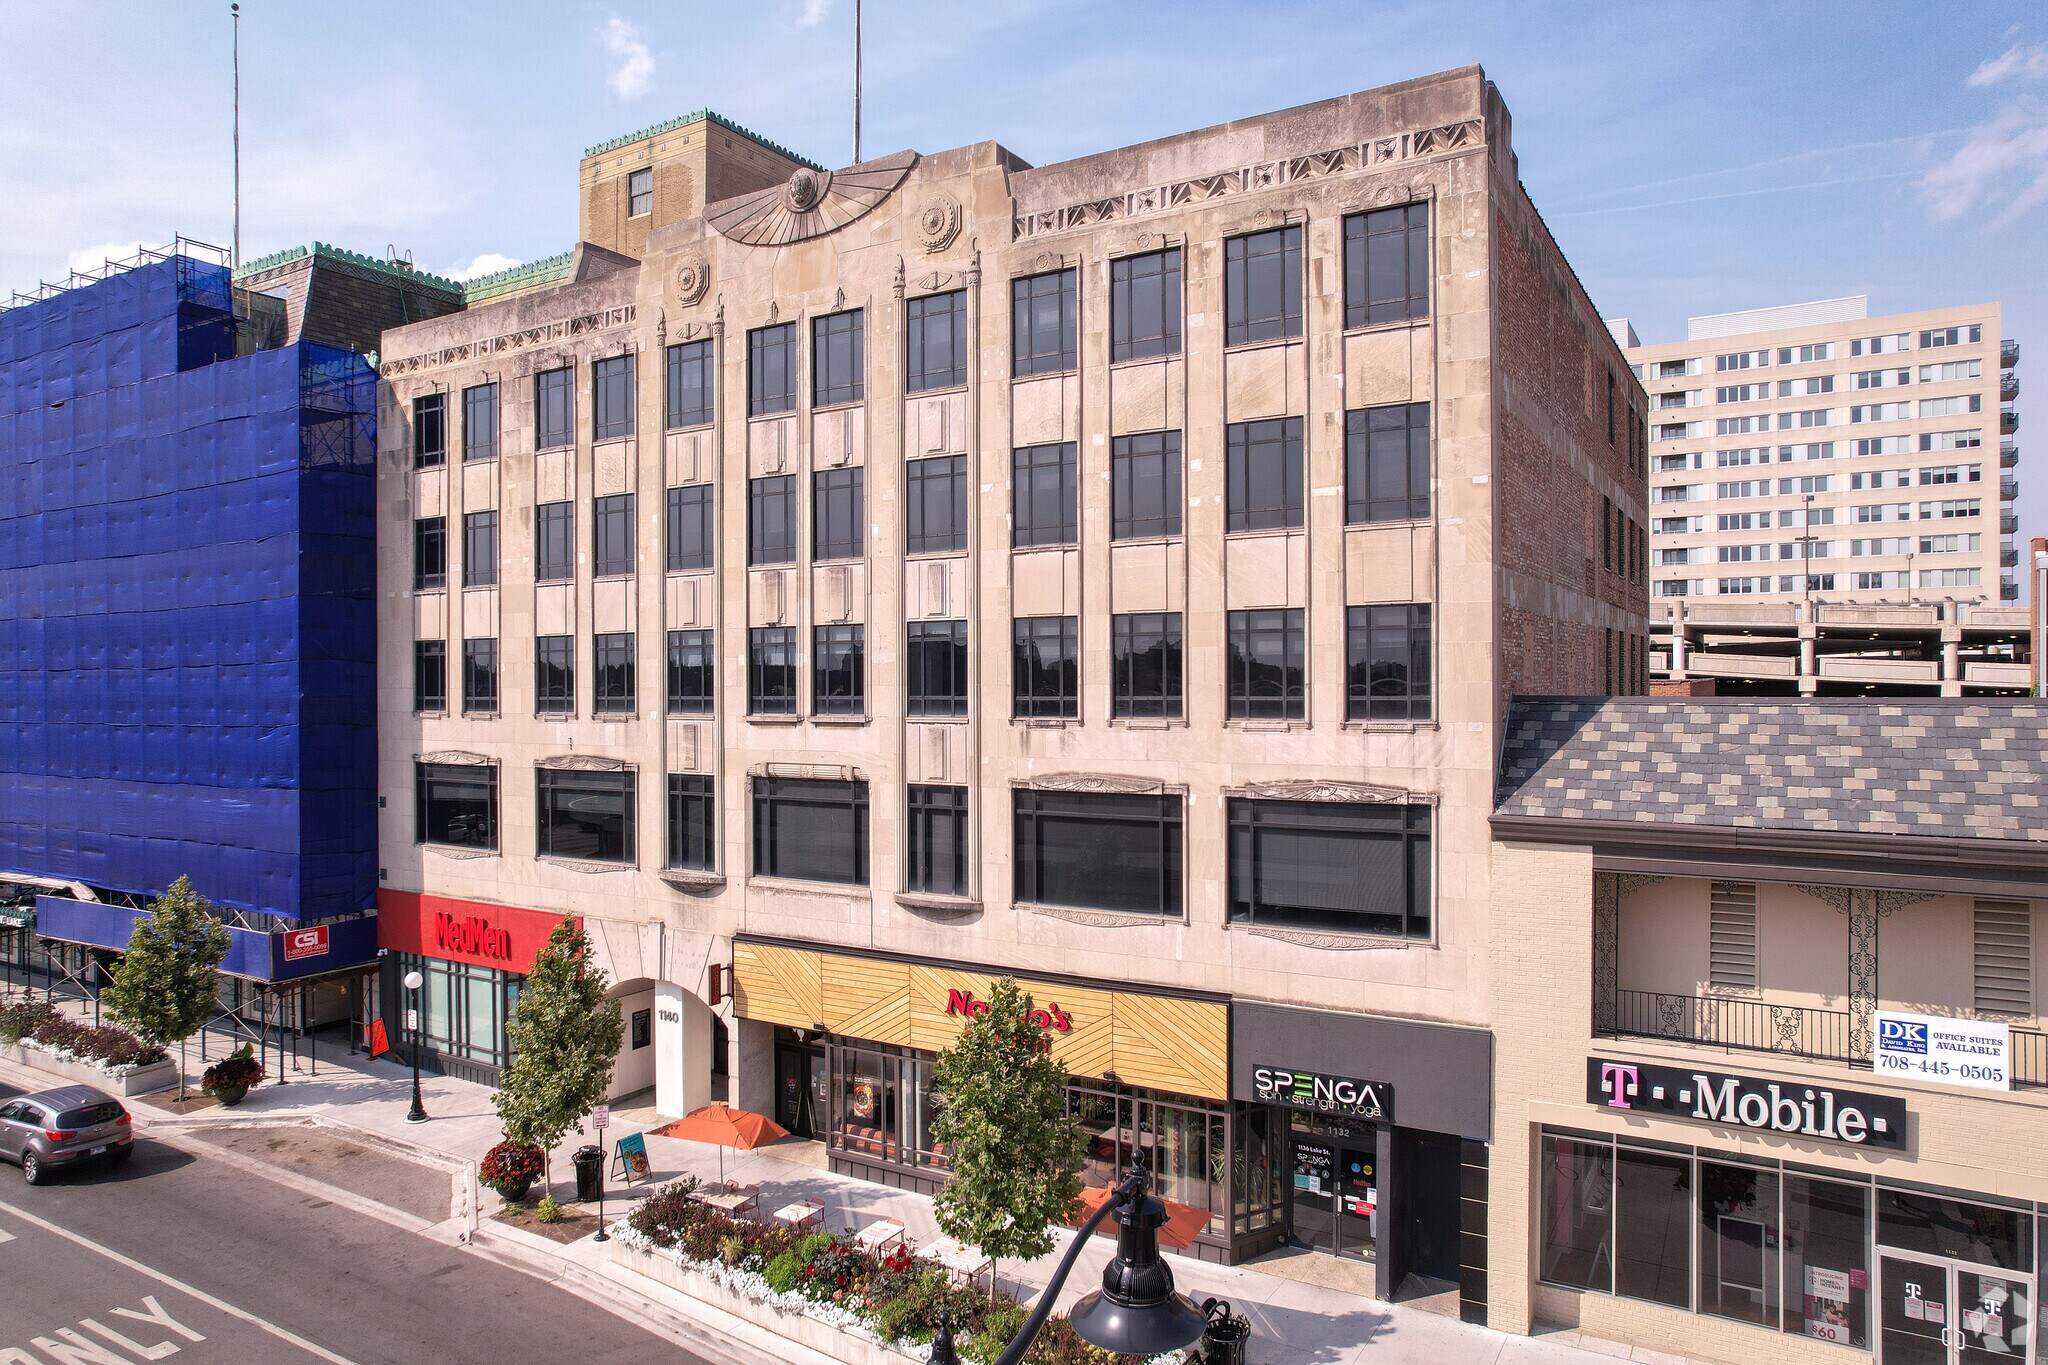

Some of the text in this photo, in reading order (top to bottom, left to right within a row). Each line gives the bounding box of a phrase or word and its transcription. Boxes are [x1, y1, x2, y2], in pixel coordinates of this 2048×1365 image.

[294, 931, 319, 948] CSI
[435, 910, 508, 958] MedMen
[659, 1009, 680, 1023] 1140
[945, 988, 1071, 1032] Nao's
[1881, 1021, 1926, 1042] DK
[1933, 1032, 2003, 1047] OFFICE SUITES
[1936, 1042, 2001, 1056] AVAILABLE
[1879, 1054, 2003, 1082] 708-445-0505
[1255, 1069, 1380, 1107] SPENGA
[1259, 1089, 1381, 1117] spin strength yoga
[1327, 1126, 1350, 1138] 1132
[1809, 1270, 1844, 1281] INTRODUCING
[0, 1295, 207, 1365] NLY
[1812, 1324, 1836, 1340] $60
